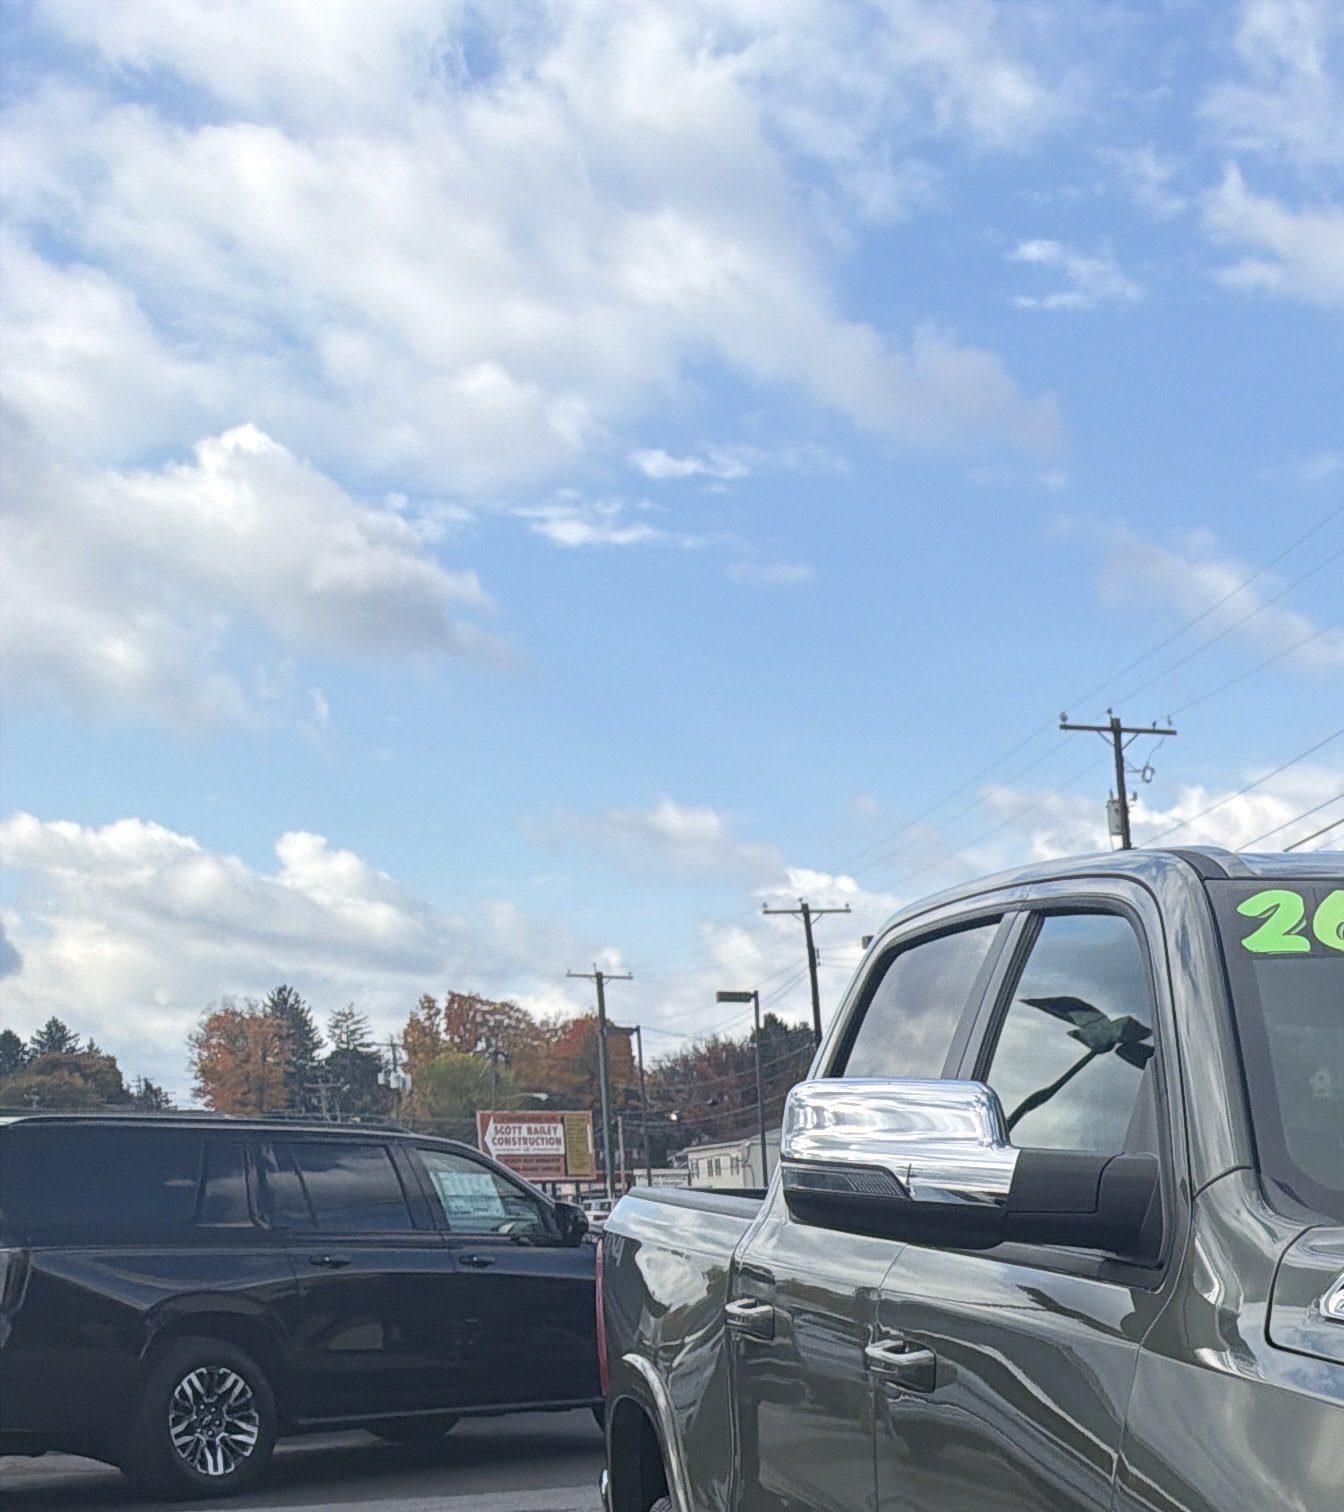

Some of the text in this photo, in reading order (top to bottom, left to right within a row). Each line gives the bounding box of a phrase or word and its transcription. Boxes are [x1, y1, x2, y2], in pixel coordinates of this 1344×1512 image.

[494, 1125, 558, 1136] SCOTT BAILEY
[492, 1136, 562, 1146] CONSTRUCTION
